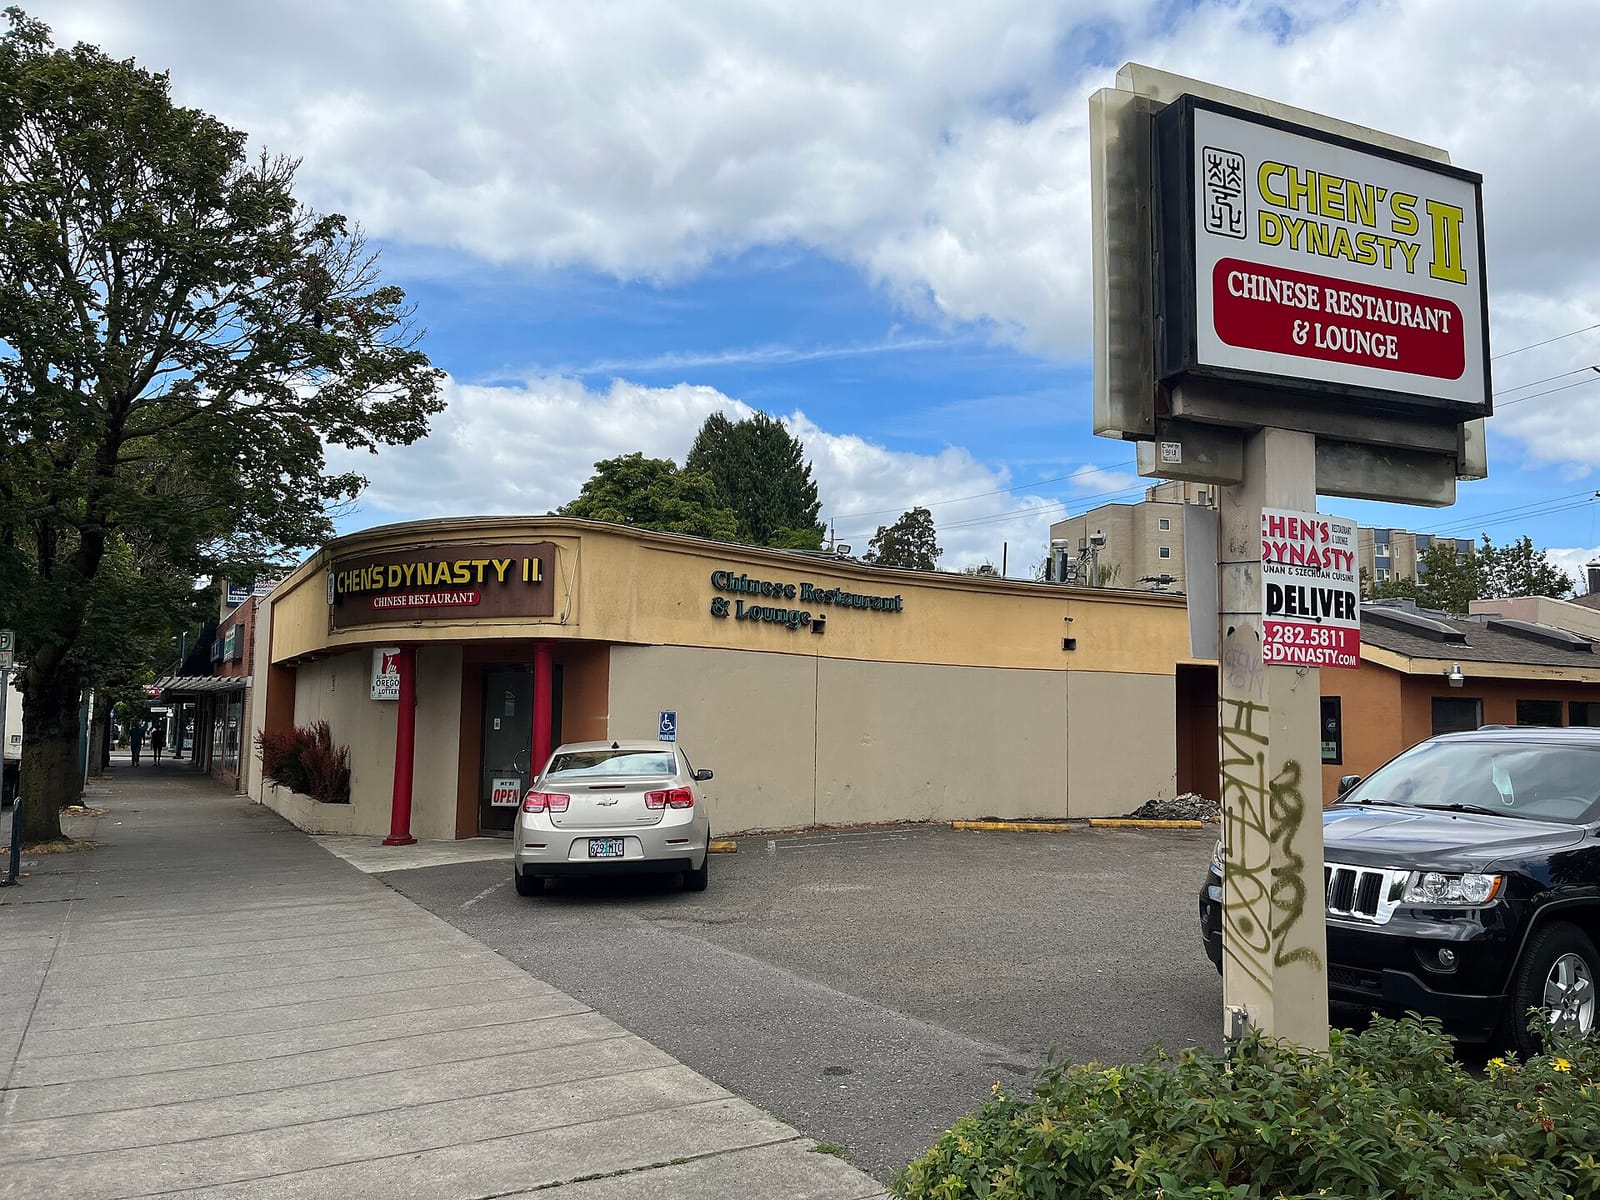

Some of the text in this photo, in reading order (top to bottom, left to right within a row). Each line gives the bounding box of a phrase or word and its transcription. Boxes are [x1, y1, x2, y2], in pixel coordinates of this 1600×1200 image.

[1257, 160, 1419, 236] CHEN'S
[1425, 199, 1467, 285] II
[1258, 210, 1421, 274] DYNASTY
[1227, 270, 1451, 333] CHINESE RESTAURANT
[1292, 320, 1398, 360] & LOUNGE
[337, 563, 384, 593] CHEN'S
[388, 558, 512, 588] DYNASTY
[522, 557, 539, 582] II
[711, 570, 904, 612] Chinese Restaurant
[1295, 567, 1331, 579] SZECHUAN
[1332, 572, 1354, 583] CUISINE
[373, 592, 474, 608] CHINESE RESTAURANT
[710, 597, 812, 630] & Lounge
[1266, 583, 1356, 621] DELIVER
[376, 679, 400, 687] OREGO
[493, 788, 519, 804] OPEN
[590, 843, 604, 853] 629
